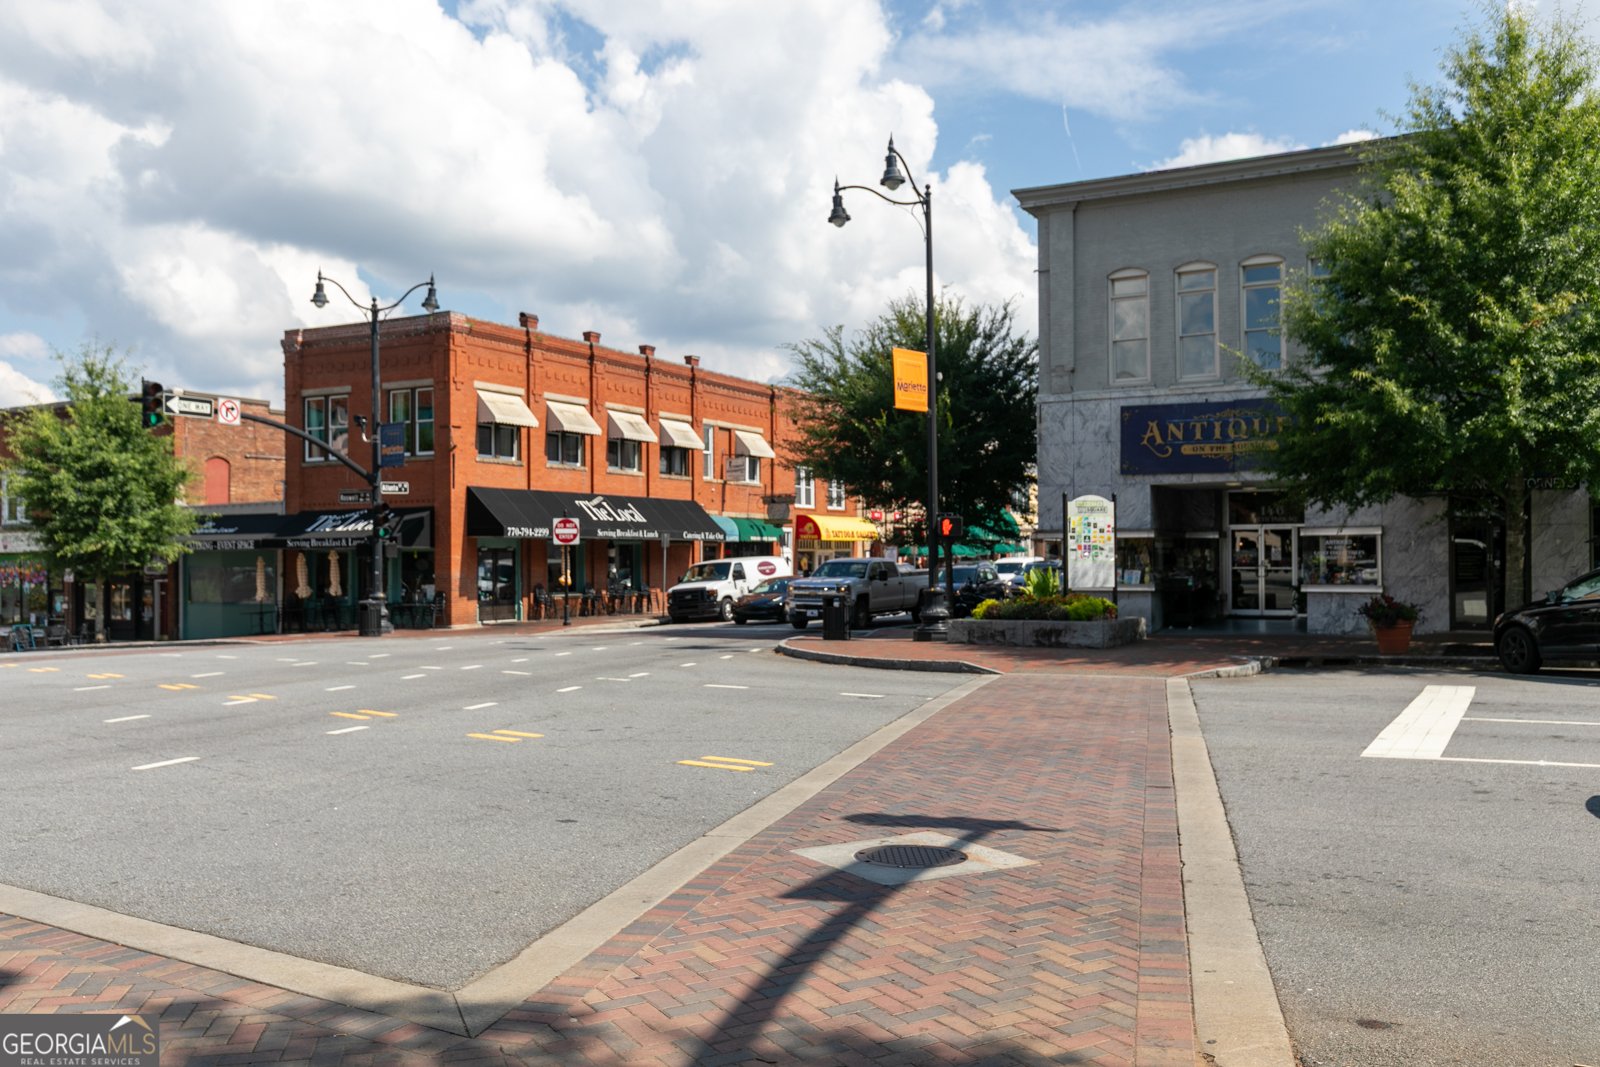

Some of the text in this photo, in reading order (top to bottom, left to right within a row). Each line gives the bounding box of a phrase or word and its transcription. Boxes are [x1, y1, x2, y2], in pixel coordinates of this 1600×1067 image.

[178, 401, 191, 410] ONE
[575, 500, 609, 521] The
[602, 501, 647, 523] Local
[507, 527, 549, 537] 770-794-2299
[597, 529, 617, 538] Serving
[617, 529, 639, 538] Breakfast
[644, 530, 658, 538] Lunch
[683, 531, 701, 540] Catering
[705, 532, 716, 540] Take
[716, 532, 724, 540] Out
[217, 540, 235, 550] EVENT
[286, 540, 310, 549] Serving
[310, 538, 341, 547] Breakfast
